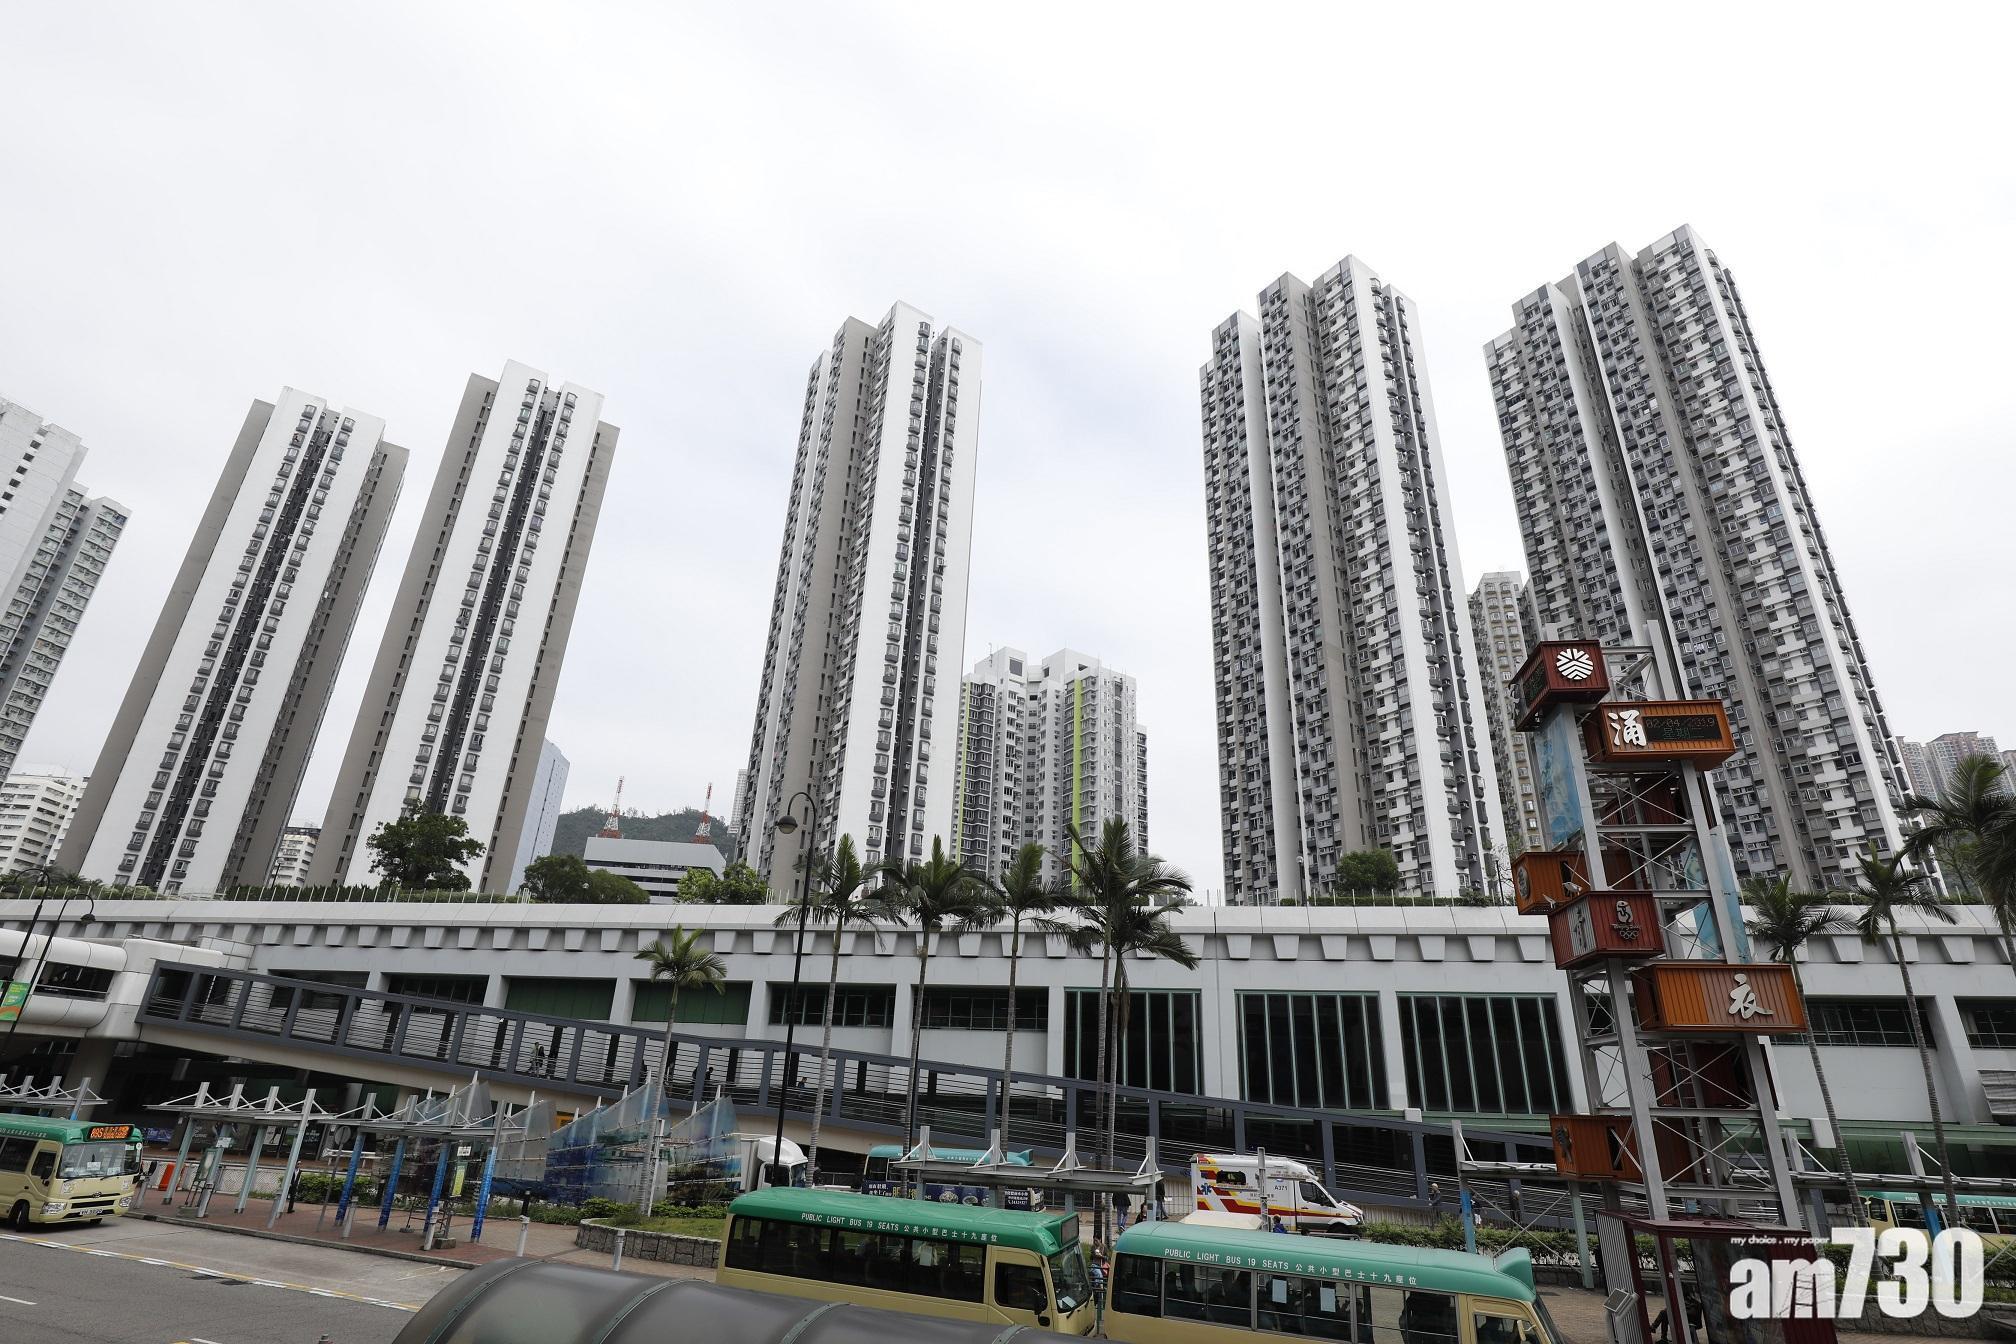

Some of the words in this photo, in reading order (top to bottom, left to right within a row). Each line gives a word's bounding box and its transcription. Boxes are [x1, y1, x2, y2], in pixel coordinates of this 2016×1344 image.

[1608, 710, 1646, 746] 涌
[801, 1212, 822, 1222] PUBLIC
[826, 1215, 845, 1225] LIGHT
[849, 1218, 862, 1227] BUS
[866, 1220, 873, 1228] 19
[878, 1222, 899, 1231] SEATS
[1164, 1248, 1191, 1259] PUBLIC
[1197, 1251, 1219, 1262] LIGHT
[1226, 1255, 1241, 1265] BUS
[1247, 1257, 1256, 1266] 19
[1262, 1259, 1289, 1270] SEATS
[1296, 1263, 1417, 1286] 公共小型巴士十九座位
